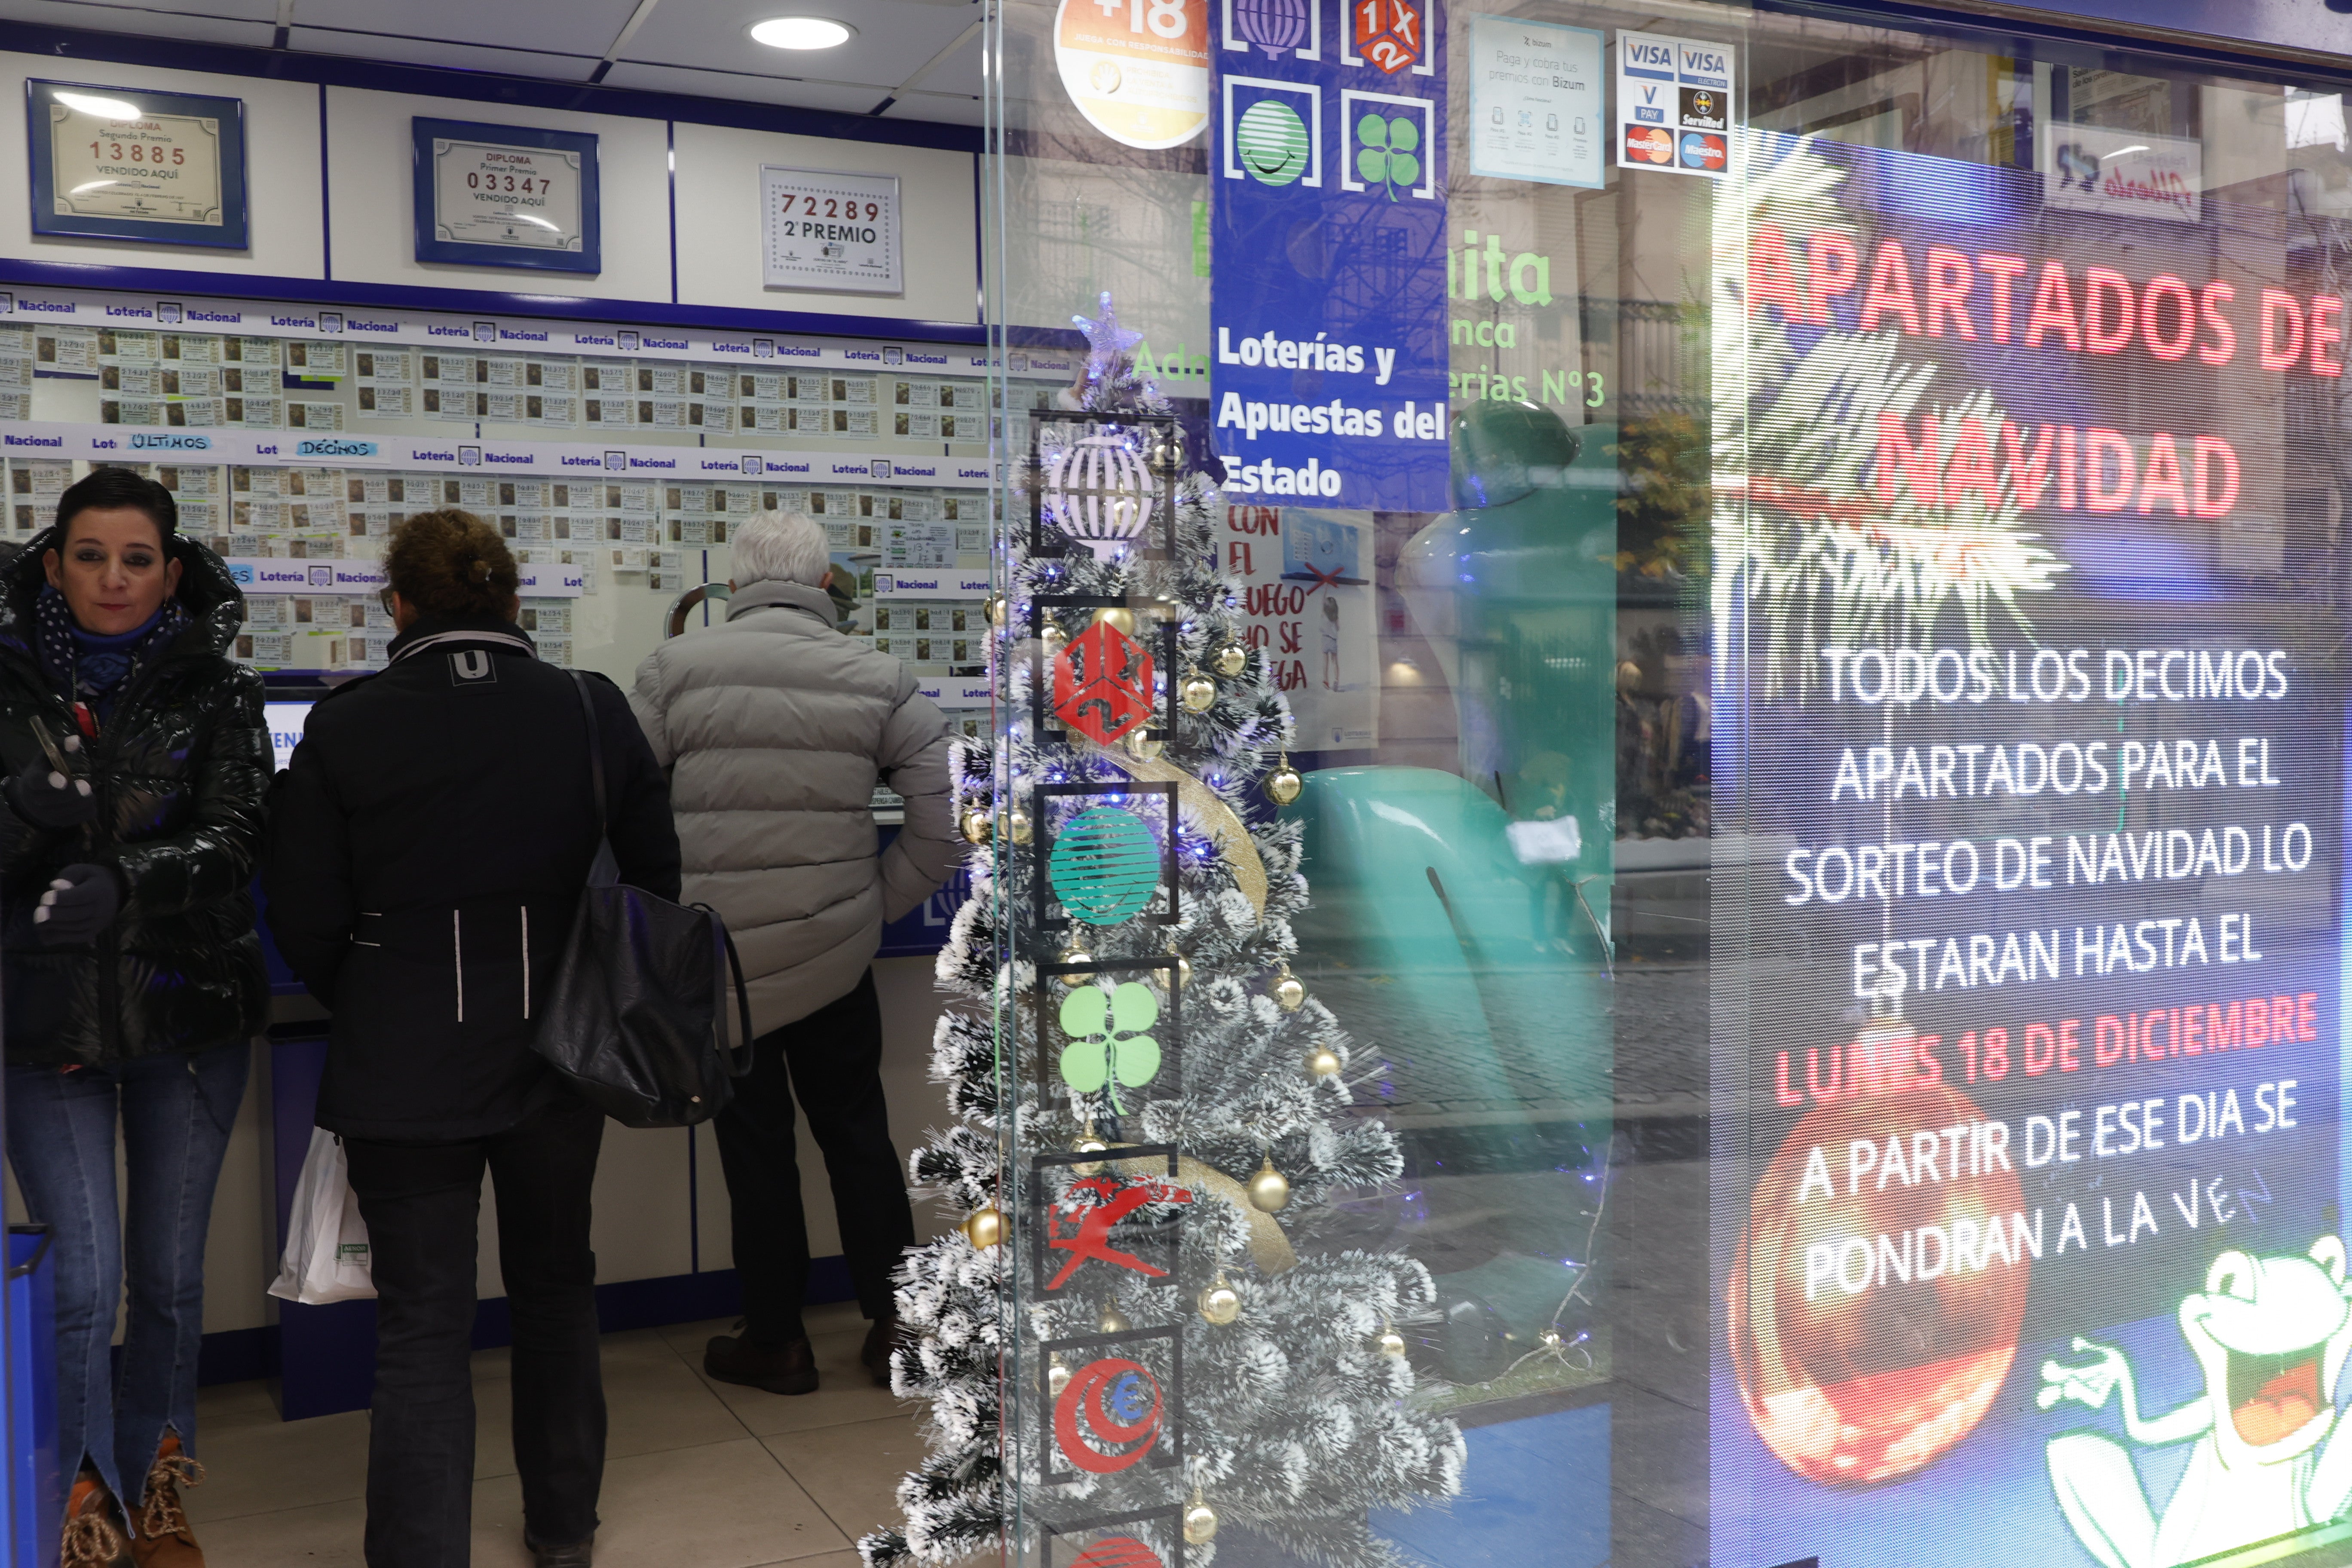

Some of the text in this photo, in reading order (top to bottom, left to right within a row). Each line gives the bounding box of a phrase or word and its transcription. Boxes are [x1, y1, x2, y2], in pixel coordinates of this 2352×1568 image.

[1075, 33, 1105, 44] JUEGA
[1106, 38, 1126, 48] CON
[1532, 38, 1551, 49] bizum
[1496, 50, 1578, 73] Paga y cobra tus
[1629, 43, 1672, 67] VISA
[1684, 50, 1725, 74] VISA
[1489, 69, 1585, 92] premios con Bizum
[1697, 77, 1726, 87] ELECTRON
[1641, 85, 1657, 105] V
[1640, 107, 1660, 121] PAY
[1682, 113, 1724, 130] ServiRed
[110, 119, 162, 131] DIPLOMA
[99, 129, 138, 141] Segundo
[89, 141, 184, 165] 13885
[1627, 137, 1672, 153] MasterCard
[1684, 144, 1724, 159] Maestro
[486, 153, 532, 165] DIPLOMA
[96, 165, 179, 180] VENDIDO AQUÍ
[480, 162, 537, 175] Primer Premio
[467, 172, 550, 195] 03347
[473, 193, 545, 206] VENDIDO AQUÍ
[781, 193, 878, 222] 72289
[802, 222, 876, 244] PREMIO
[18, 300, 76, 313] Nacional
[1748, 222, 2343, 377] APARTADOS DE
[106, 306, 241, 323] Lotería Nacional
[271, 316, 398, 333] Lotería Nacional
[428, 325, 548, 342] Lotería Nacional
[575, 334, 689, 350] Lotería Nacional
[1452, 319, 1517, 349] nca
[712, 342, 821, 357] Lotería Nacional
[845, 350, 948, 364] Lotería Nacional
[1218, 326, 1396, 386] Loterías y
[1030, 360, 1069, 370] Nacional
[1217, 391, 1446, 441] Apuestas del
[4, 435, 63, 447] Nacional
[412, 450, 534, 464] Lotería Nacional
[561, 456, 677, 469] Lotería Nacional
[1875, 410, 2241, 519] NAVIDAD
[701, 460, 810, 473] Lotería Nacional
[832, 464, 936, 476] Lotería Nacional
[1221, 456, 1342, 498] Estado
[1227, 505, 1279, 536] CON
[1228, 541, 1256, 575] EL
[260, 571, 387, 584] Lotería Naciona
[896, 580, 938, 590] Nacional
[1243, 583, 1305, 617] UEGO
[1279, 621, 1303, 654] SE
[453, 649, 490, 679] U
[1822, 647, 2288, 704] TODOS LOS DECIMOS
[1830, 738, 2280, 801] APARTADOS PARA EL
[1785, 822, 2313, 906] SORTEO DE NAVIDAD LO
[1853, 912, 2262, 998] ESTARAN HASTA EL
[1957, 1026, 2009, 1083] 18
[2024, 1020, 2080, 1076] DE
[2095, 991, 2318, 1067] DICIEMBRE
[1798, 1080, 2298, 1203] A PARTIR DE ESE DIA SE
[1805, 1198, 2043, 1302] PONDRAN
[2057, 1201, 2087, 1254] A
[2102, 1191, 2158, 1247] LA
